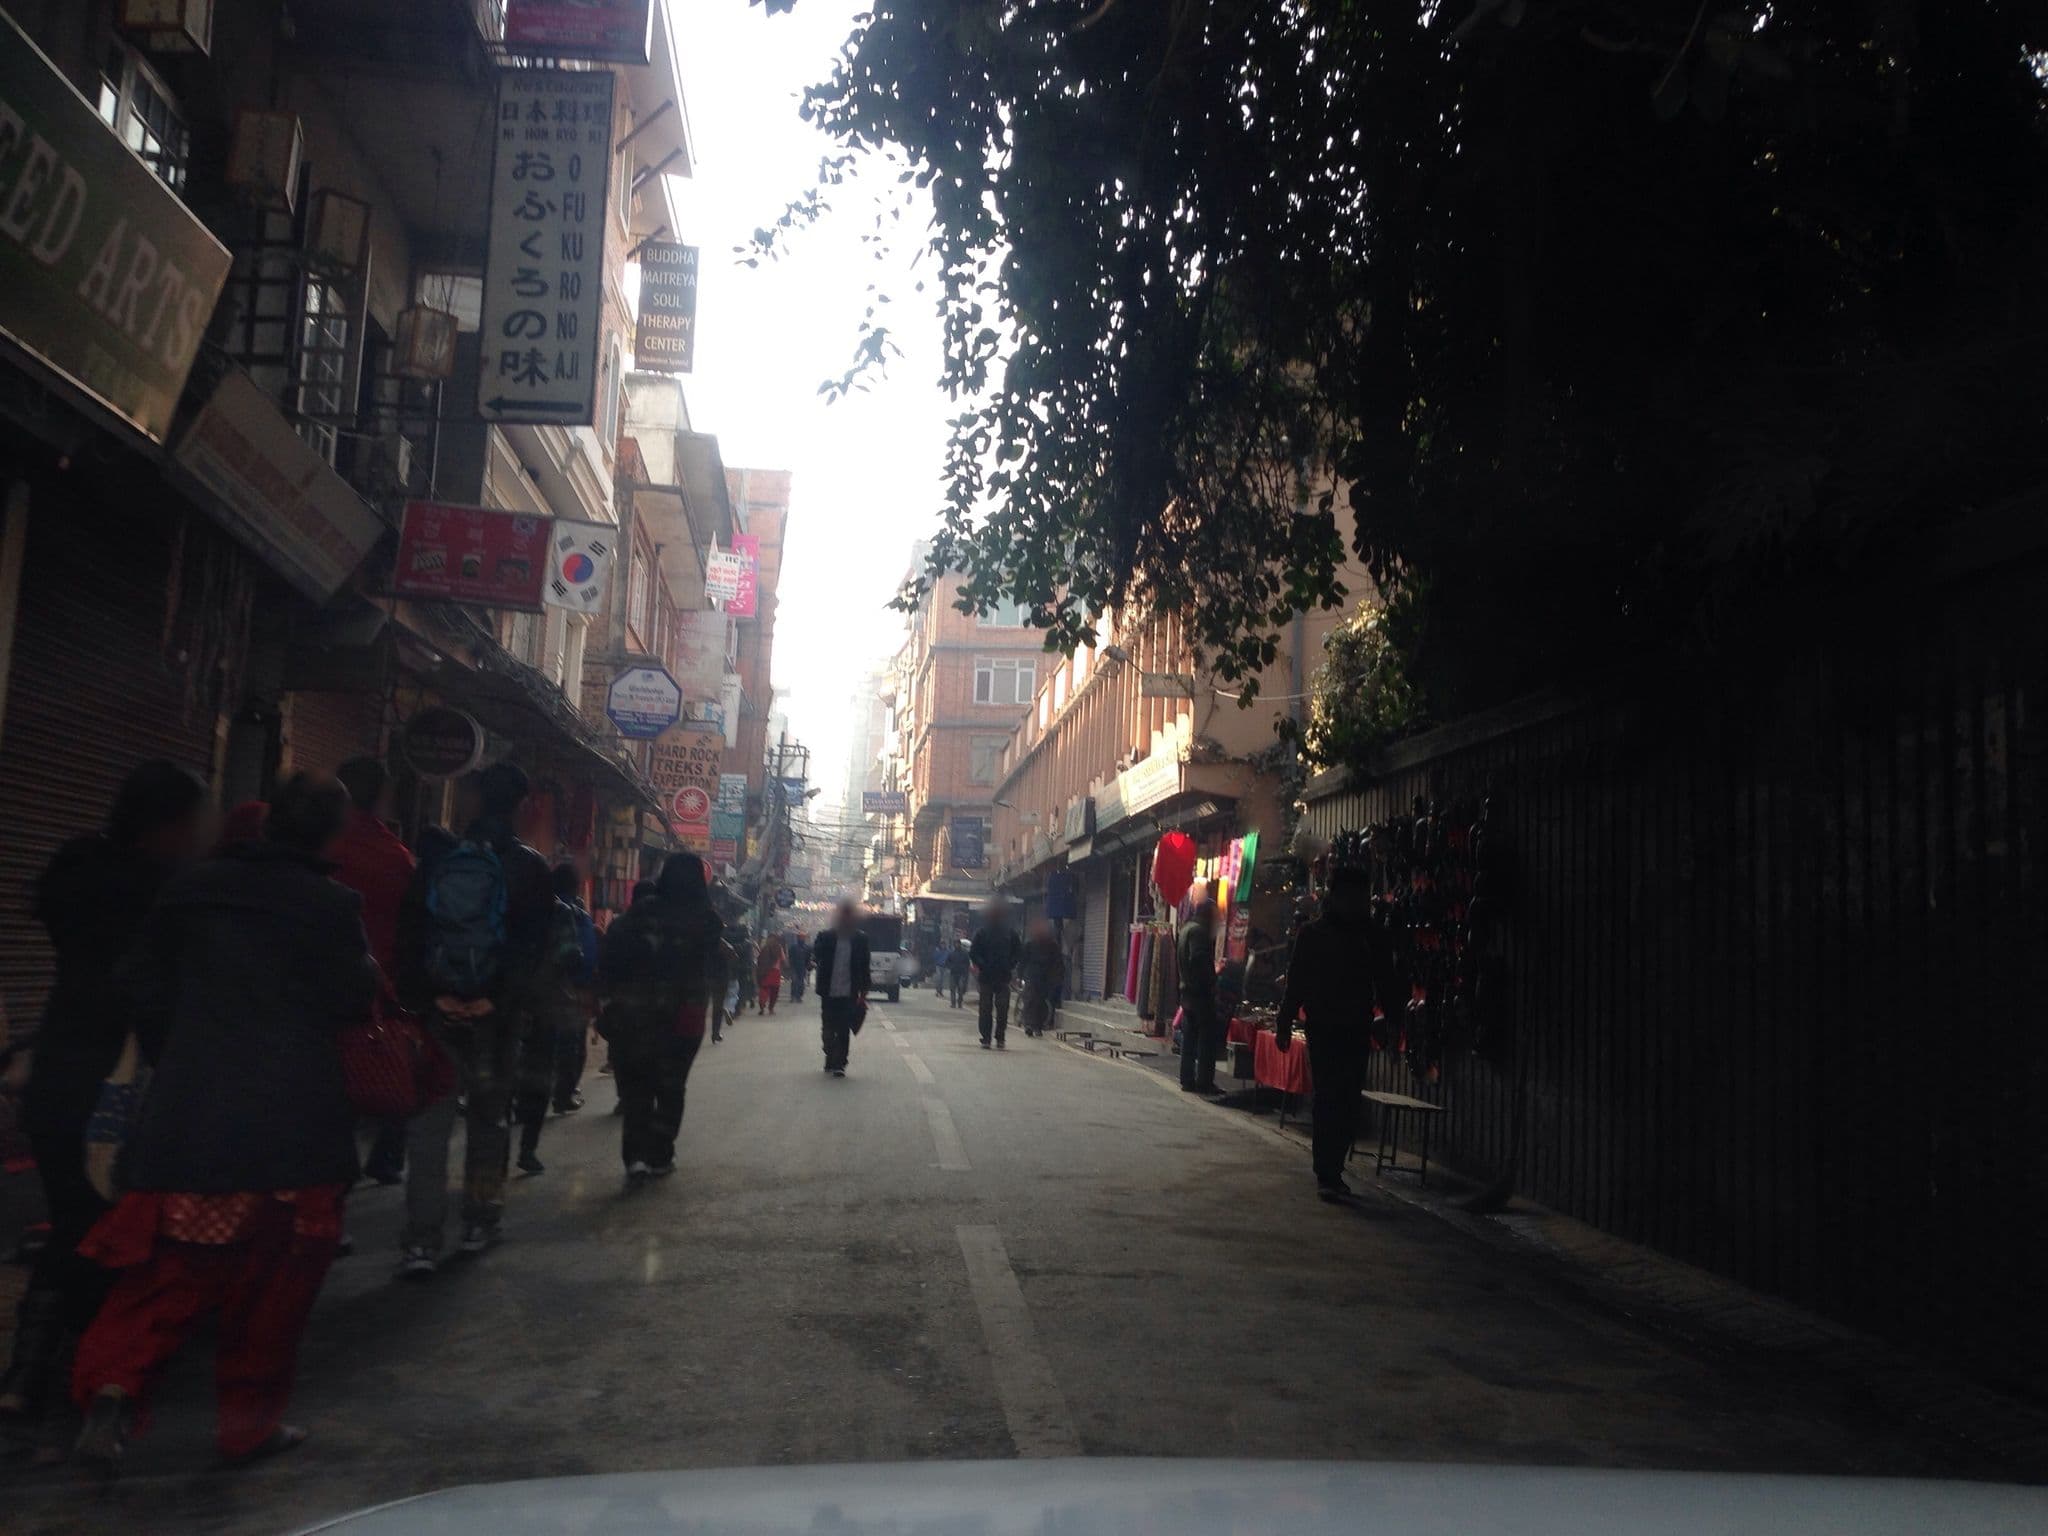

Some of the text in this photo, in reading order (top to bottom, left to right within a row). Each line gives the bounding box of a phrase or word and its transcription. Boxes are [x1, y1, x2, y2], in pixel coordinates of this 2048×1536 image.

[563, 192, 586, 223] FU
[561, 231, 584, 262] KU
[646, 249, 695, 266] BUDDHA
[501, 151, 557, 387] おふくろの味
[642, 269, 696, 288] MAITREYA
[76, 217, 202, 368] ARTS
[559, 271, 582, 301] RO
[653, 293, 682, 309] SOUL
[556, 311, 579, 340] NO
[642, 313, 692, 332] THERAPY
[644, 335, 687, 353] CENTER
[555, 351, 580, 380] AJI
[656, 743, 720, 763] HARD ROCK
[656, 758, 718, 776] TREKS &
[653, 773, 712, 792] EXPEDITION
